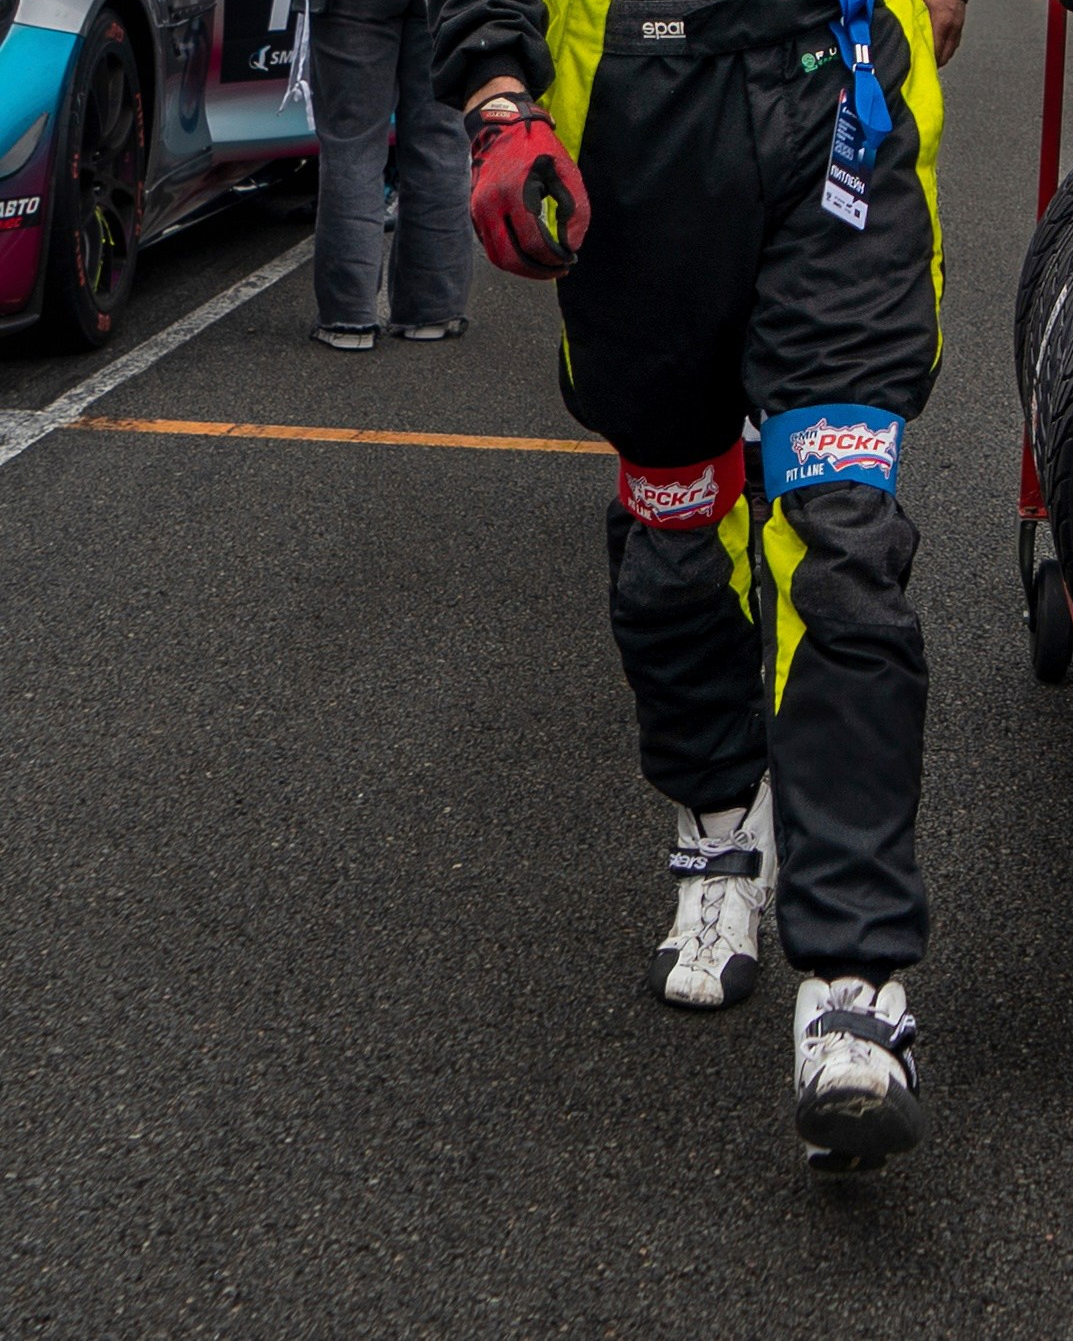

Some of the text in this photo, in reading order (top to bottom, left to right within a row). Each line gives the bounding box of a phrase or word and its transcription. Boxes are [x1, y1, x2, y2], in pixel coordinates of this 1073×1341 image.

[818, 433, 886, 451] РСКГ
[786, 462, 826, 483] PIT LANE
[644, 488, 703, 507] РСКГ
